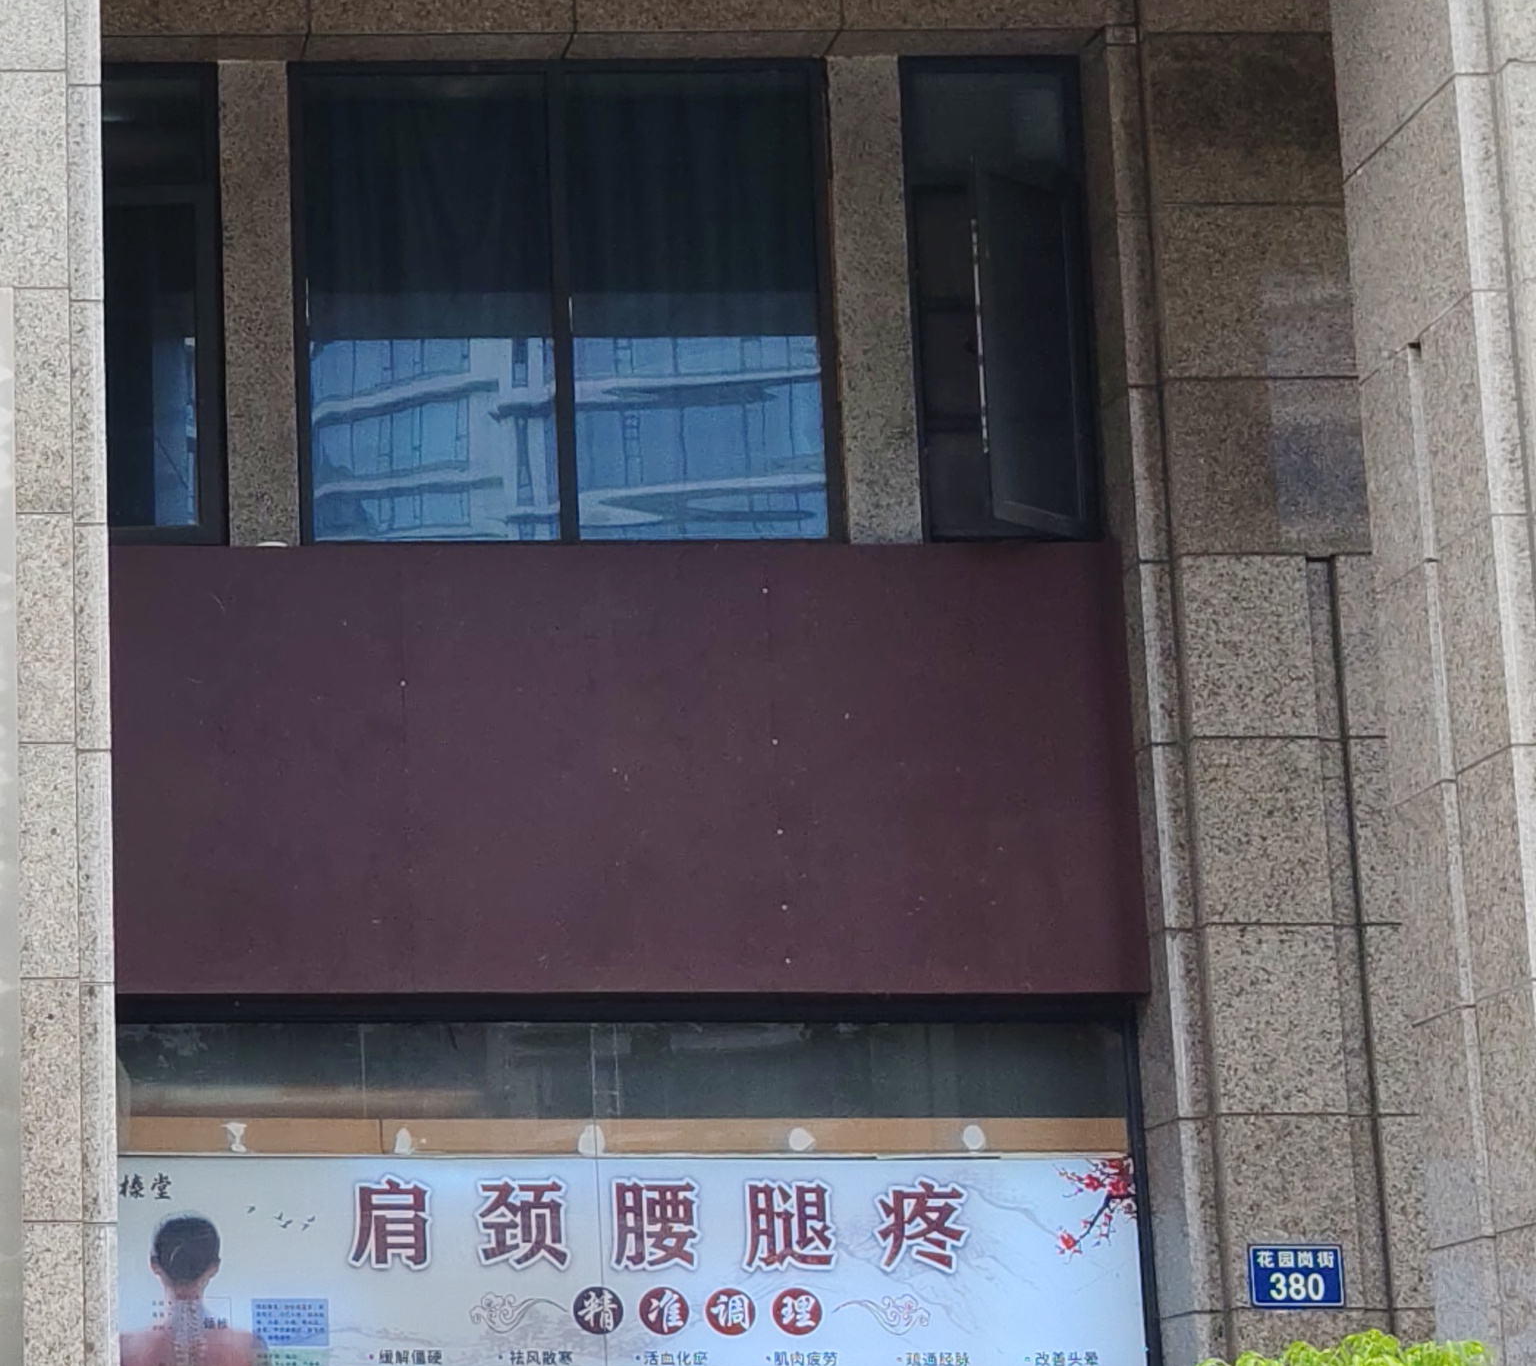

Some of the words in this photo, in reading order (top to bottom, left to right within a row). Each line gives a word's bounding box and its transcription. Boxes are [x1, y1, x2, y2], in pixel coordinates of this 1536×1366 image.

[352, 1178, 966, 1271] 肩颈腰腿疼
[1255, 1250, 1335, 1269] 花园岗街
[1269, 1272, 1325, 1302] 380
[576, 1289, 819, 1334] 精准调理
[378, 1349, 443, 1366] 缓解僵硬
[509, 1350, 574, 1366] 祛风散寒
[643, 1350, 709, 1366] 活血化瘀
[773, 1351, 839, 1366] 肌肉疲劳
[1034, 1351, 1100, 1366] 改善头晕
